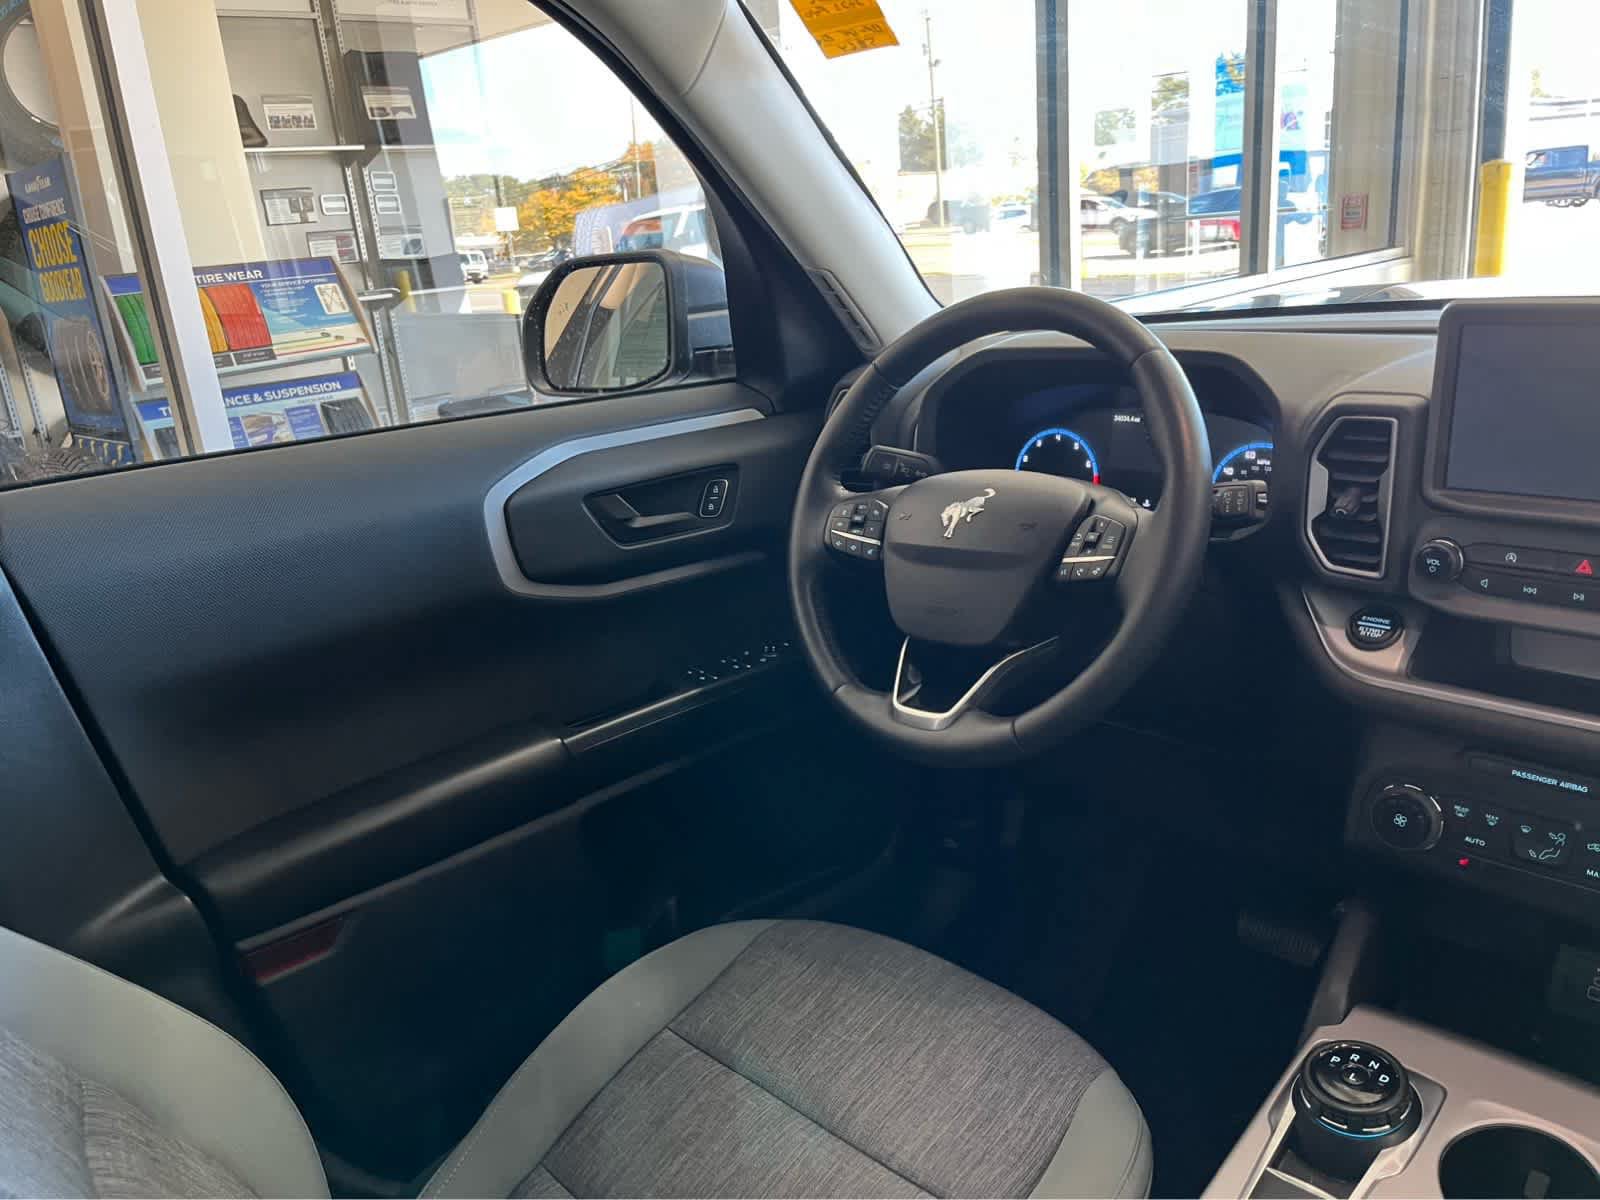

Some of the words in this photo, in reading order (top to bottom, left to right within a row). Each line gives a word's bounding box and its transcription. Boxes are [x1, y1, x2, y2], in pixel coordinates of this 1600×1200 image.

[28, 221, 77, 269] CHOOSE
[39, 267, 87, 303] GOODYEAR
[195, 273, 225, 284] TIRE
[225, 270, 263, 281] WEAR
[254, 392, 266, 403] &
[265, 381, 341, 401] SUSPENSION
[1361, 616, 1390, 624] ENGINE
[1512, 770, 1558, 785] PASSENGER
[1559, 781, 1588, 792] AIRBAG
[1465, 836, 1485, 846] AUTO
[1349, 1073, 1356, 1081] L
[1368, 1060, 1379, 1069] N
[1378, 1074, 1390, 1083] D
